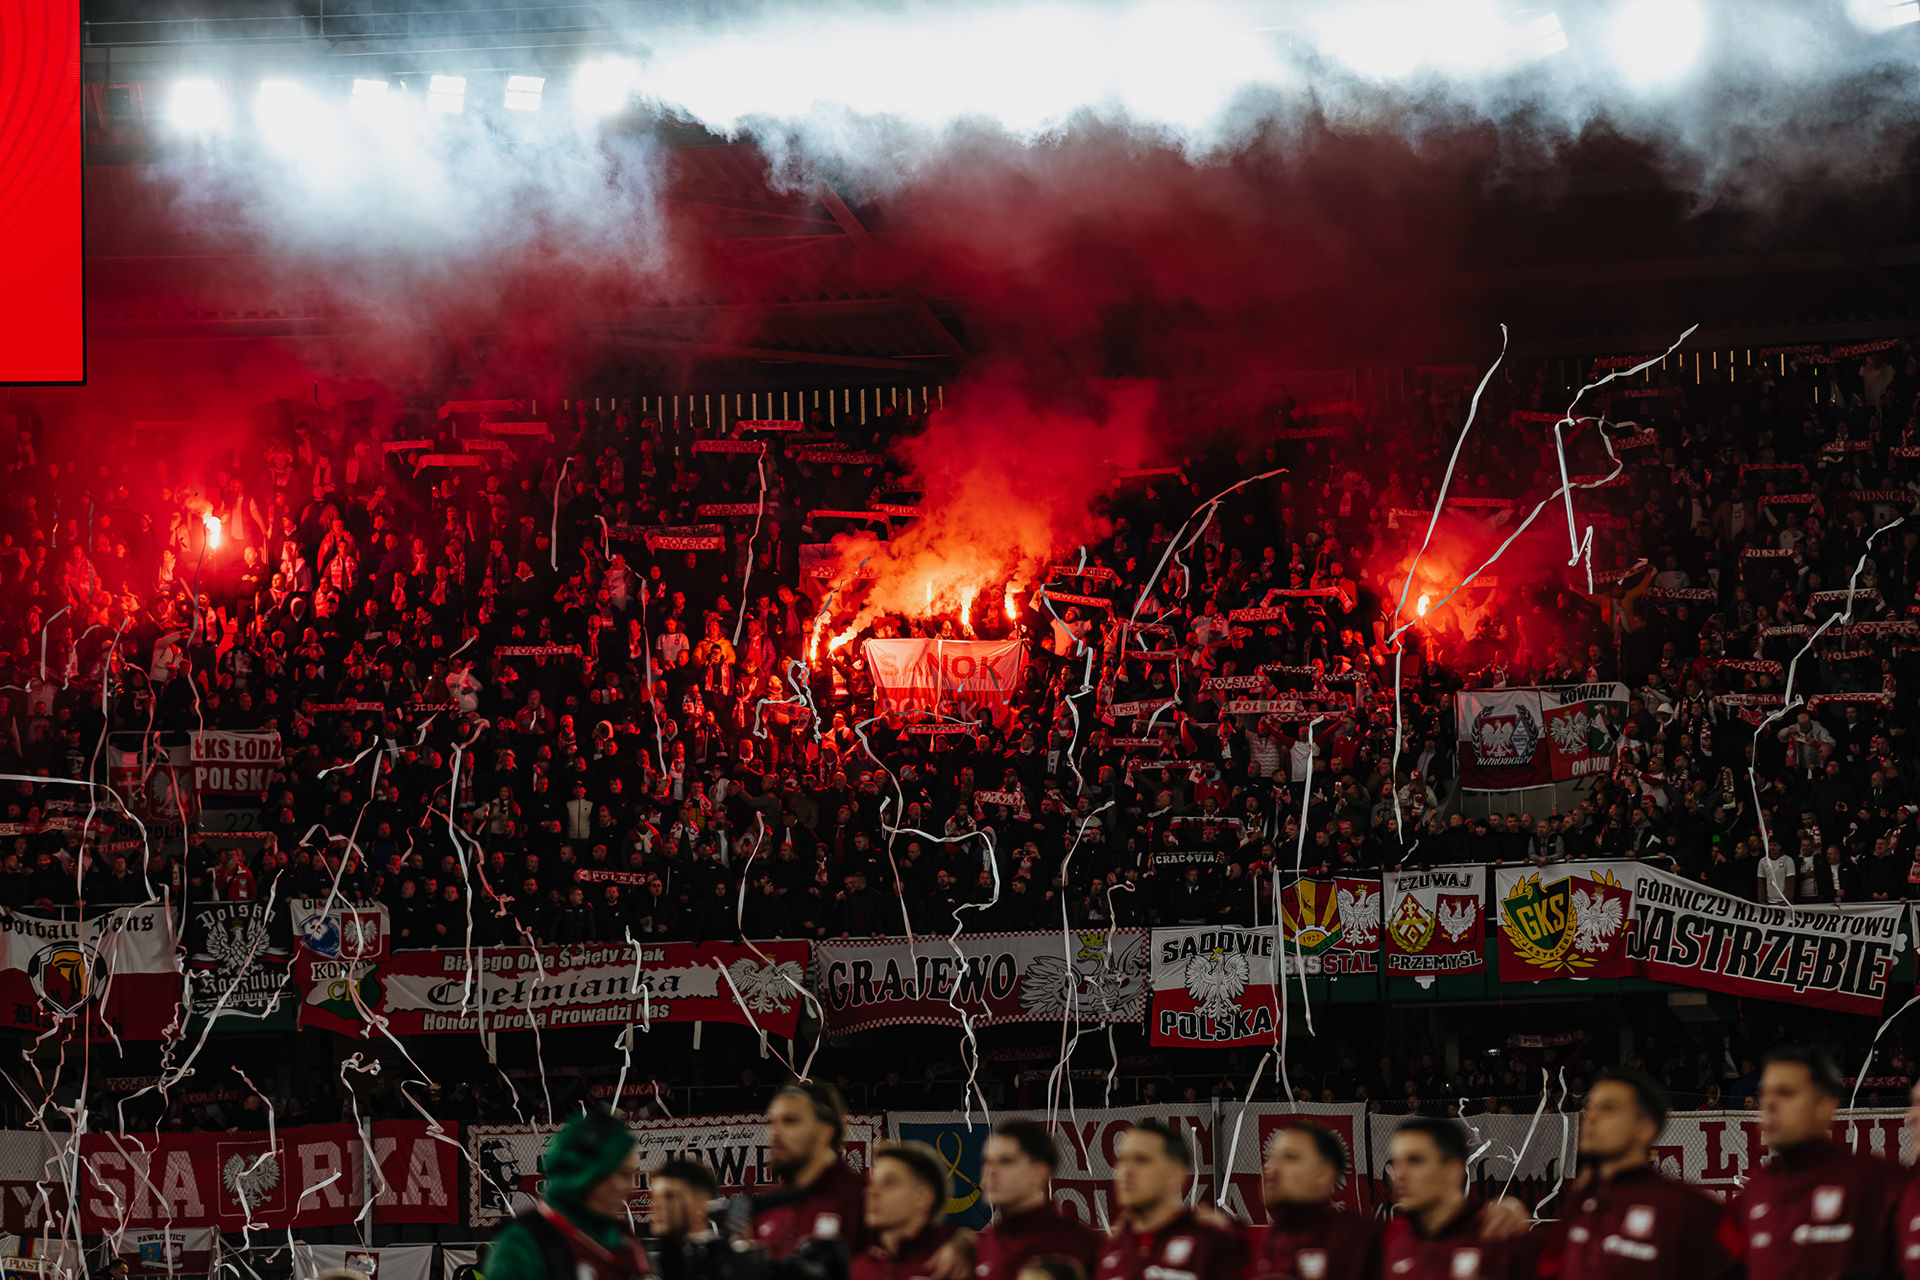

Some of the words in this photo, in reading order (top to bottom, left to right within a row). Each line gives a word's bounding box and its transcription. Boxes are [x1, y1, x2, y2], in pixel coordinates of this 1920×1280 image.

[879, 652, 1003, 680] SANOK
[1279, 690, 1338, 701] POLSKA
[1560, 684, 1617, 705] KOWARY
[1119, 705, 1138, 713] POL
[1235, 702, 1258, 711] POL
[1269, 702, 1291, 710] SKA
[195, 739, 230, 760] ŁKS
[592, 873, 646, 883] POLSKA
[1397, 872, 1473, 891] CZUWAJ
[1516, 893, 1565, 942] GKS
[1637, 878, 1732, 916] GÓRNICZY
[1733, 903, 1785, 928] KLUB
[1788, 912, 1897, 938] SPORTOWY
[1302, 934, 1320, 943] 1922
[1388, 950, 1483, 970] PRZEMYŚL
[1626, 903, 1893, 1000] JASTRZĘBIE
[1323, 953, 1378, 975] STAL
[828, 951, 1018, 1012] GRAJEWO
[550, 1003, 633, 1026] Prowadzi
[1160, 1006, 1274, 1041] POLSKA
[639, 1132, 684, 1145] Ojczyzny
